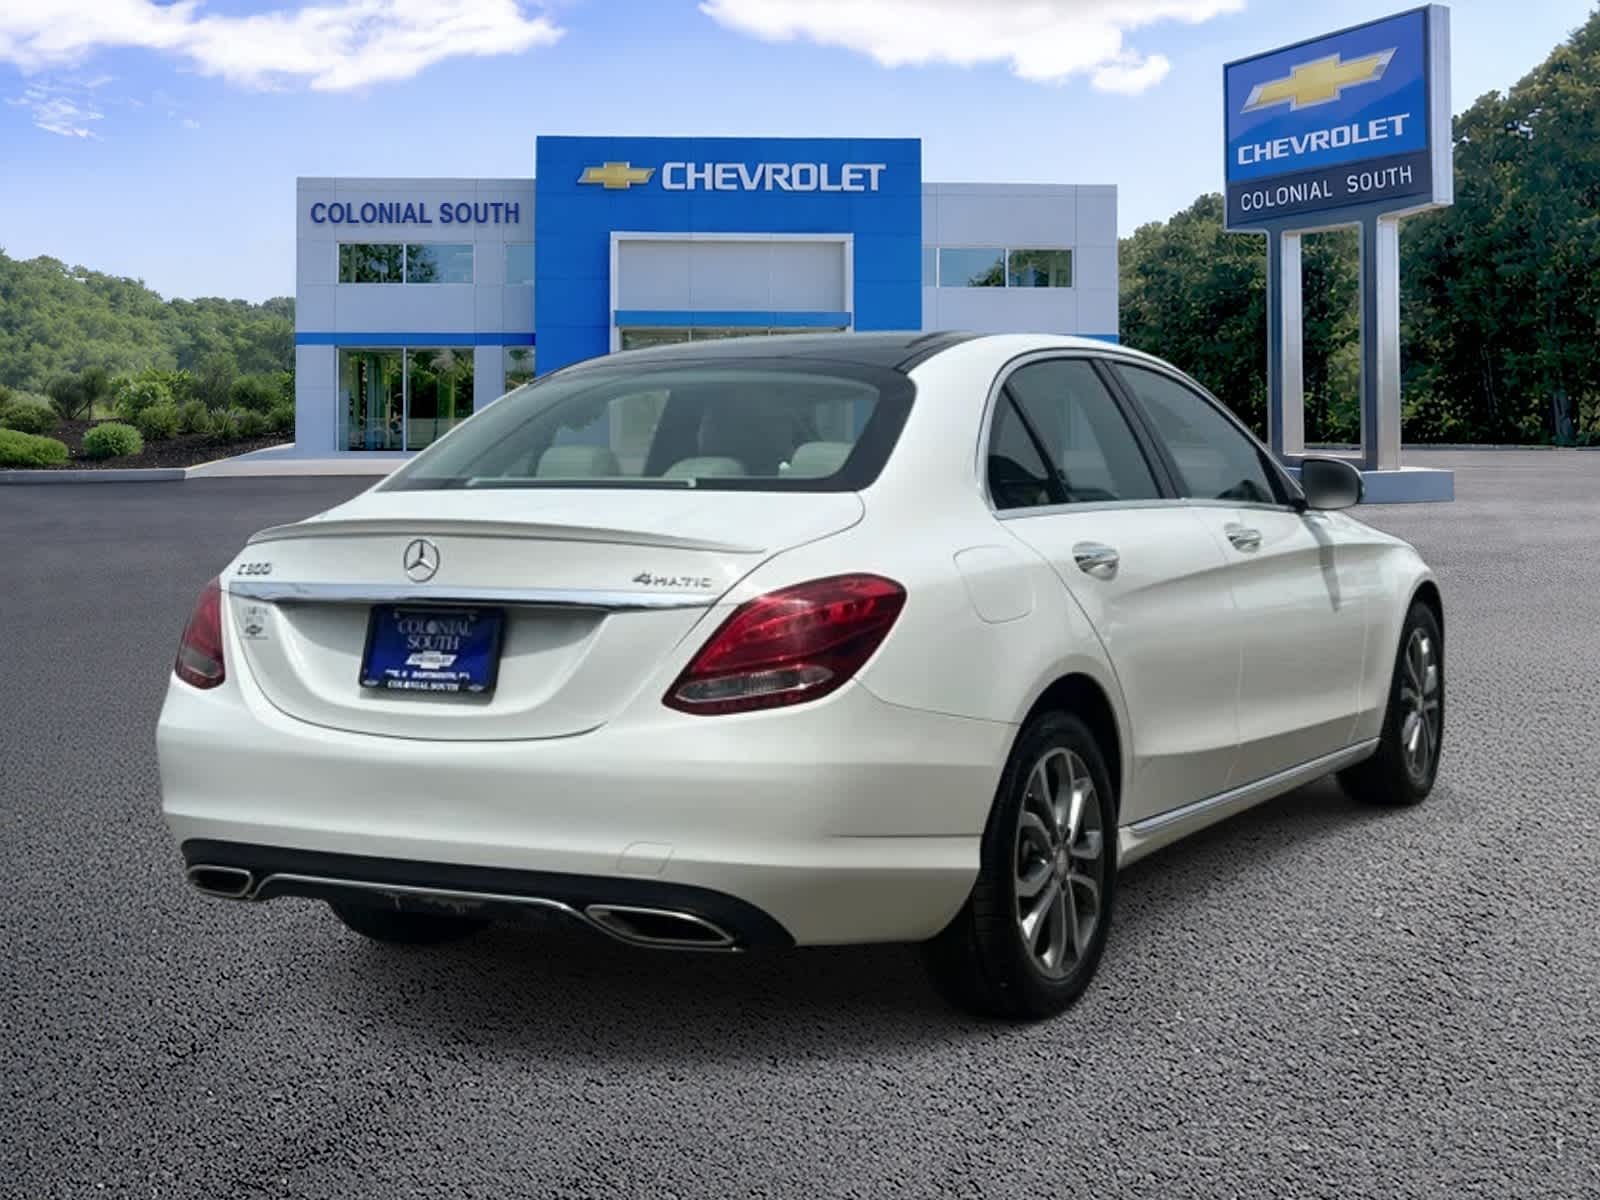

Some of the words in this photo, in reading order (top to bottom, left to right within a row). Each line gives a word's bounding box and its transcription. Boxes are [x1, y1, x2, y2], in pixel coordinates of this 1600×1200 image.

[1237, 112, 1410, 165] CHEVROLET
[662, 161, 887, 192] CHEVROLET
[1240, 179, 1333, 212] COLONIAL
[1346, 165, 1413, 194] SOUTH
[310, 202, 433, 225] COLONIAL
[439, 202, 520, 225] SOUTH
[398, 619, 472, 637] COLONIAL
[407, 635, 460, 651] SOUTH
